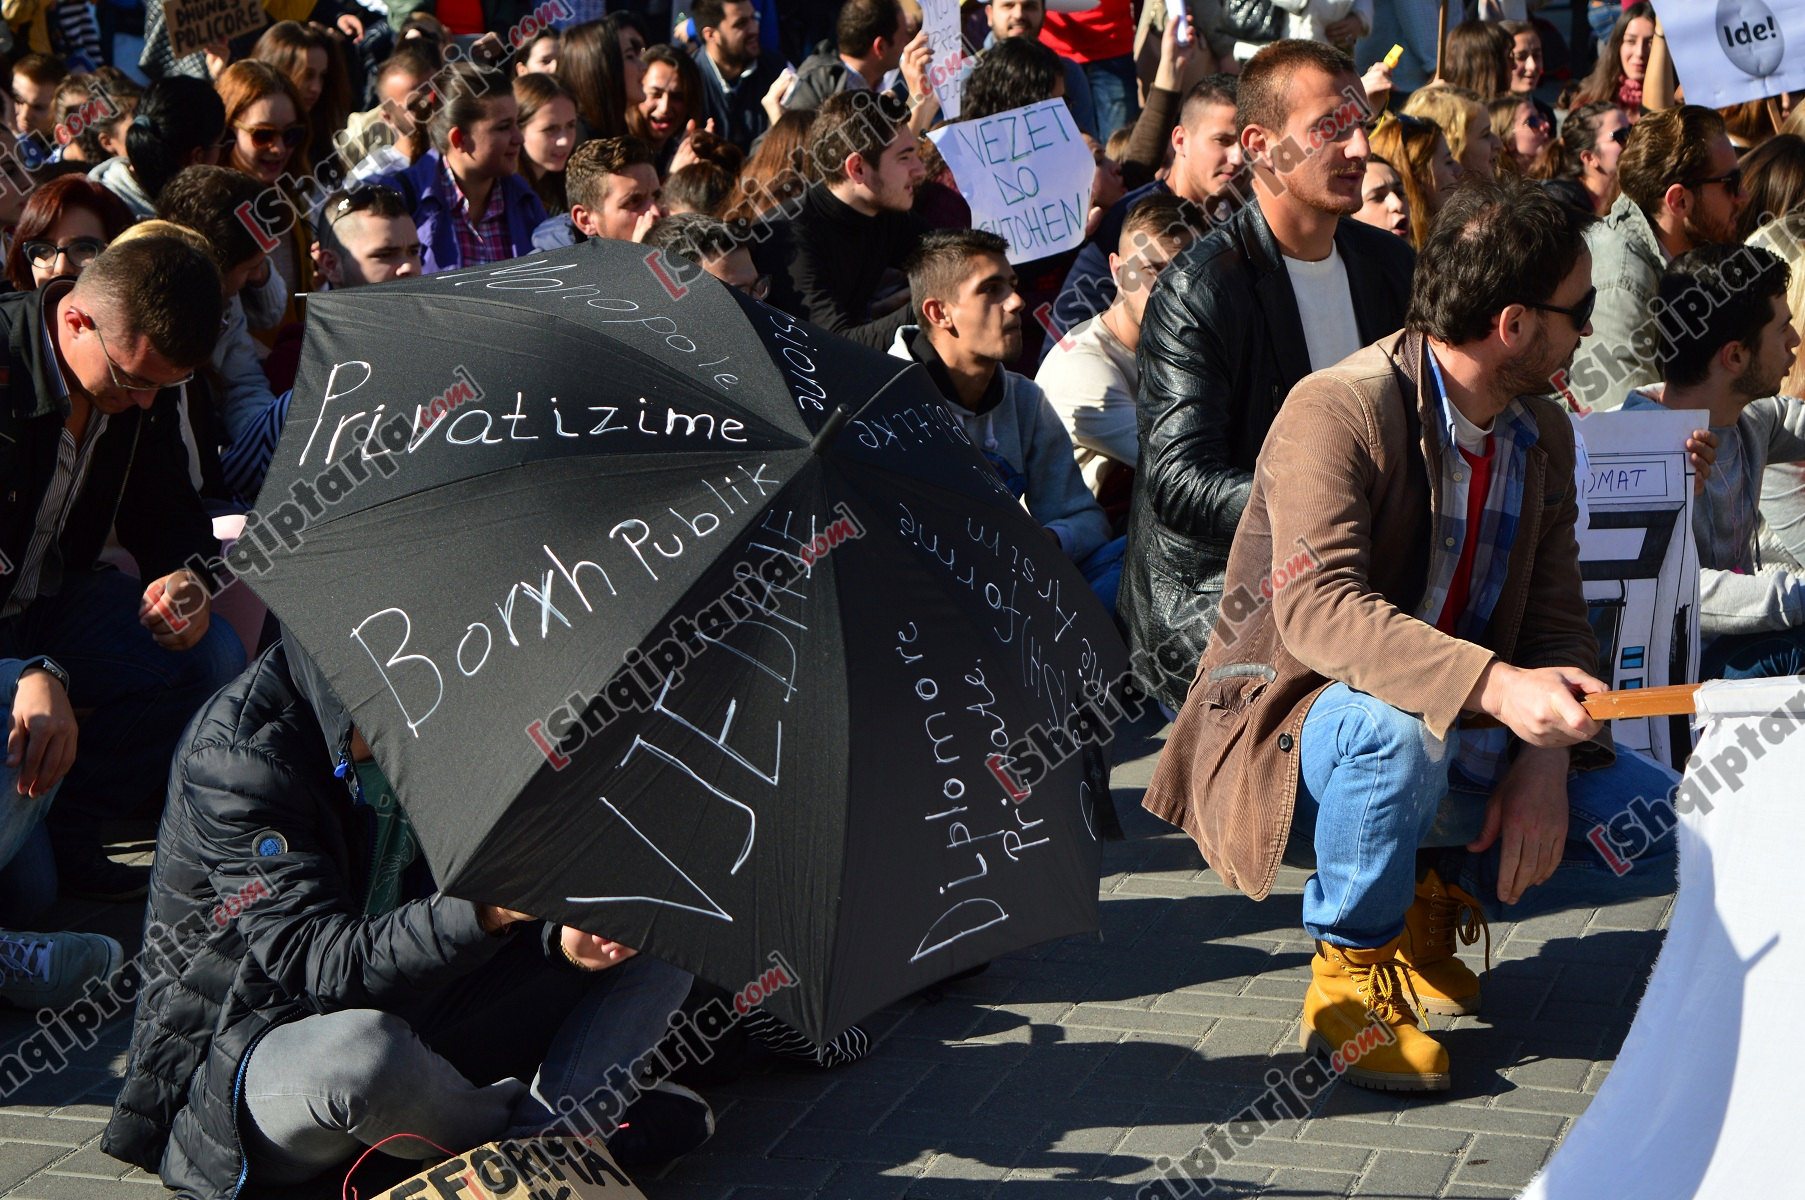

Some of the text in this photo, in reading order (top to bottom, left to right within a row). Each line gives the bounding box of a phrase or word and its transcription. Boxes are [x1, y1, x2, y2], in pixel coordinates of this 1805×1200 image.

[174, 1, 260, 53] POLICORE
[1723, 16, 1777, 48] Ide!
[958, 103, 1070, 168] VEZËT
[992, 165, 1040, 206] DO
[299, 359, 749, 467] Privatizime
[349, 462, 781, 739] Borxh Publik
[966, 516, 1077, 643] Arsim
[566, 509, 817, 922] VJEDHJE
[895, 620, 1009, 963] Diplomore
